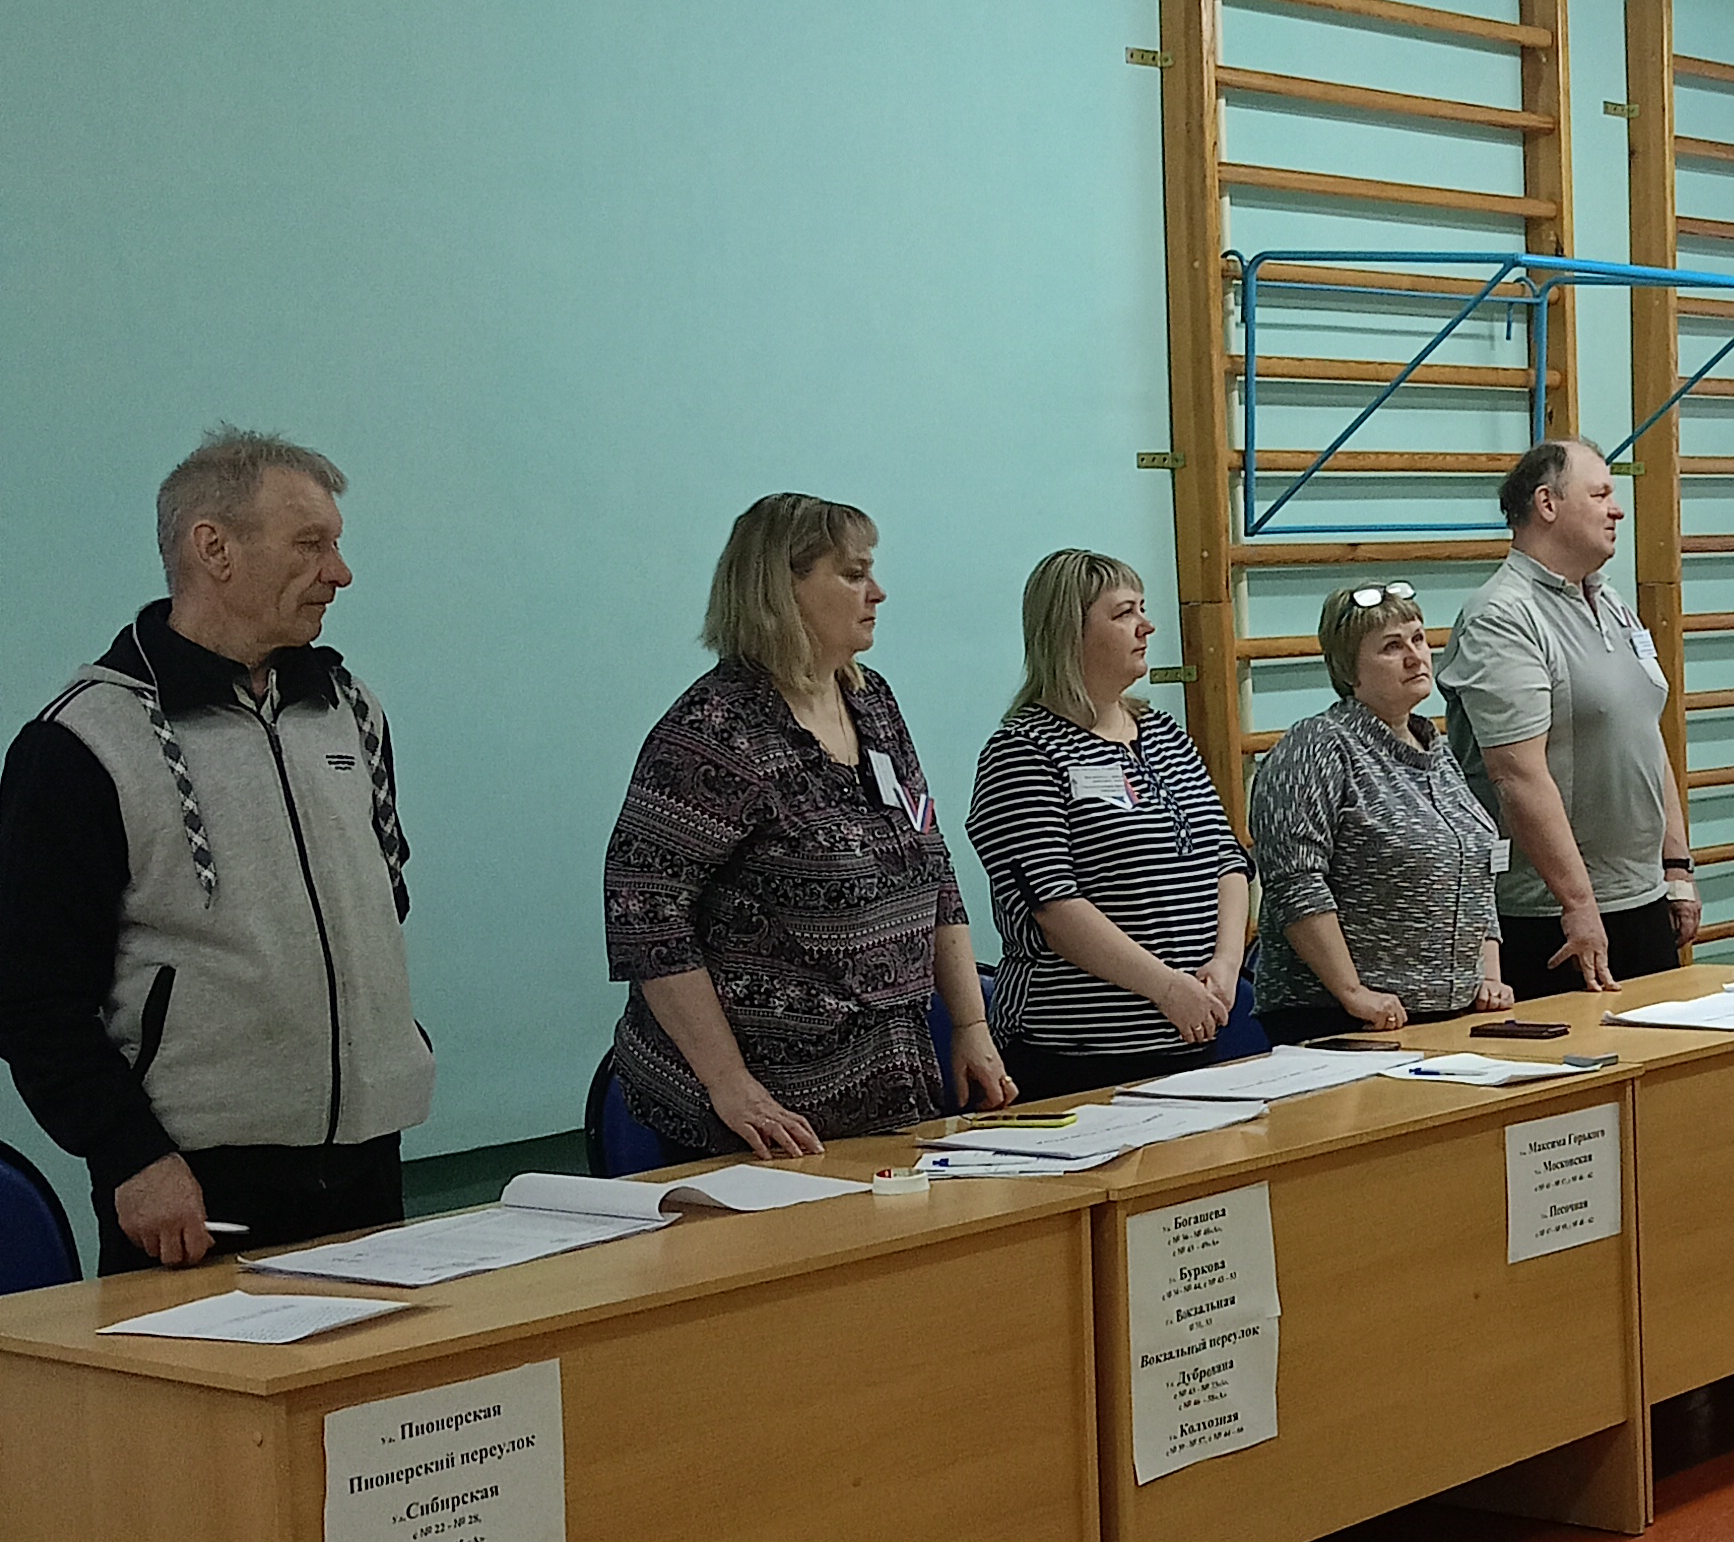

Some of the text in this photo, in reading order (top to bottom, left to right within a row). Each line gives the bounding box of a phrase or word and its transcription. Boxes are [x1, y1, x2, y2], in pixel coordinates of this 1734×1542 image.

[1528, 1138, 1566, 1153] Максима
[1568, 1129, 1605, 1146] Горького
[1543, 1154, 1593, 1171] Московская
[1174, 1208, 1226, 1230] Богашева
[1179, 1260, 1226, 1282] Буркова
[1176, 1295, 1236, 1322] Вокзальная
[1140, 1326, 1260, 1368] Вокзальный переулок
[400, 1404, 502, 1440] Пионерская
[1180, 1411, 1239, 1438] Колхозная
[349, 1434, 536, 1495] Пионерский переулок
